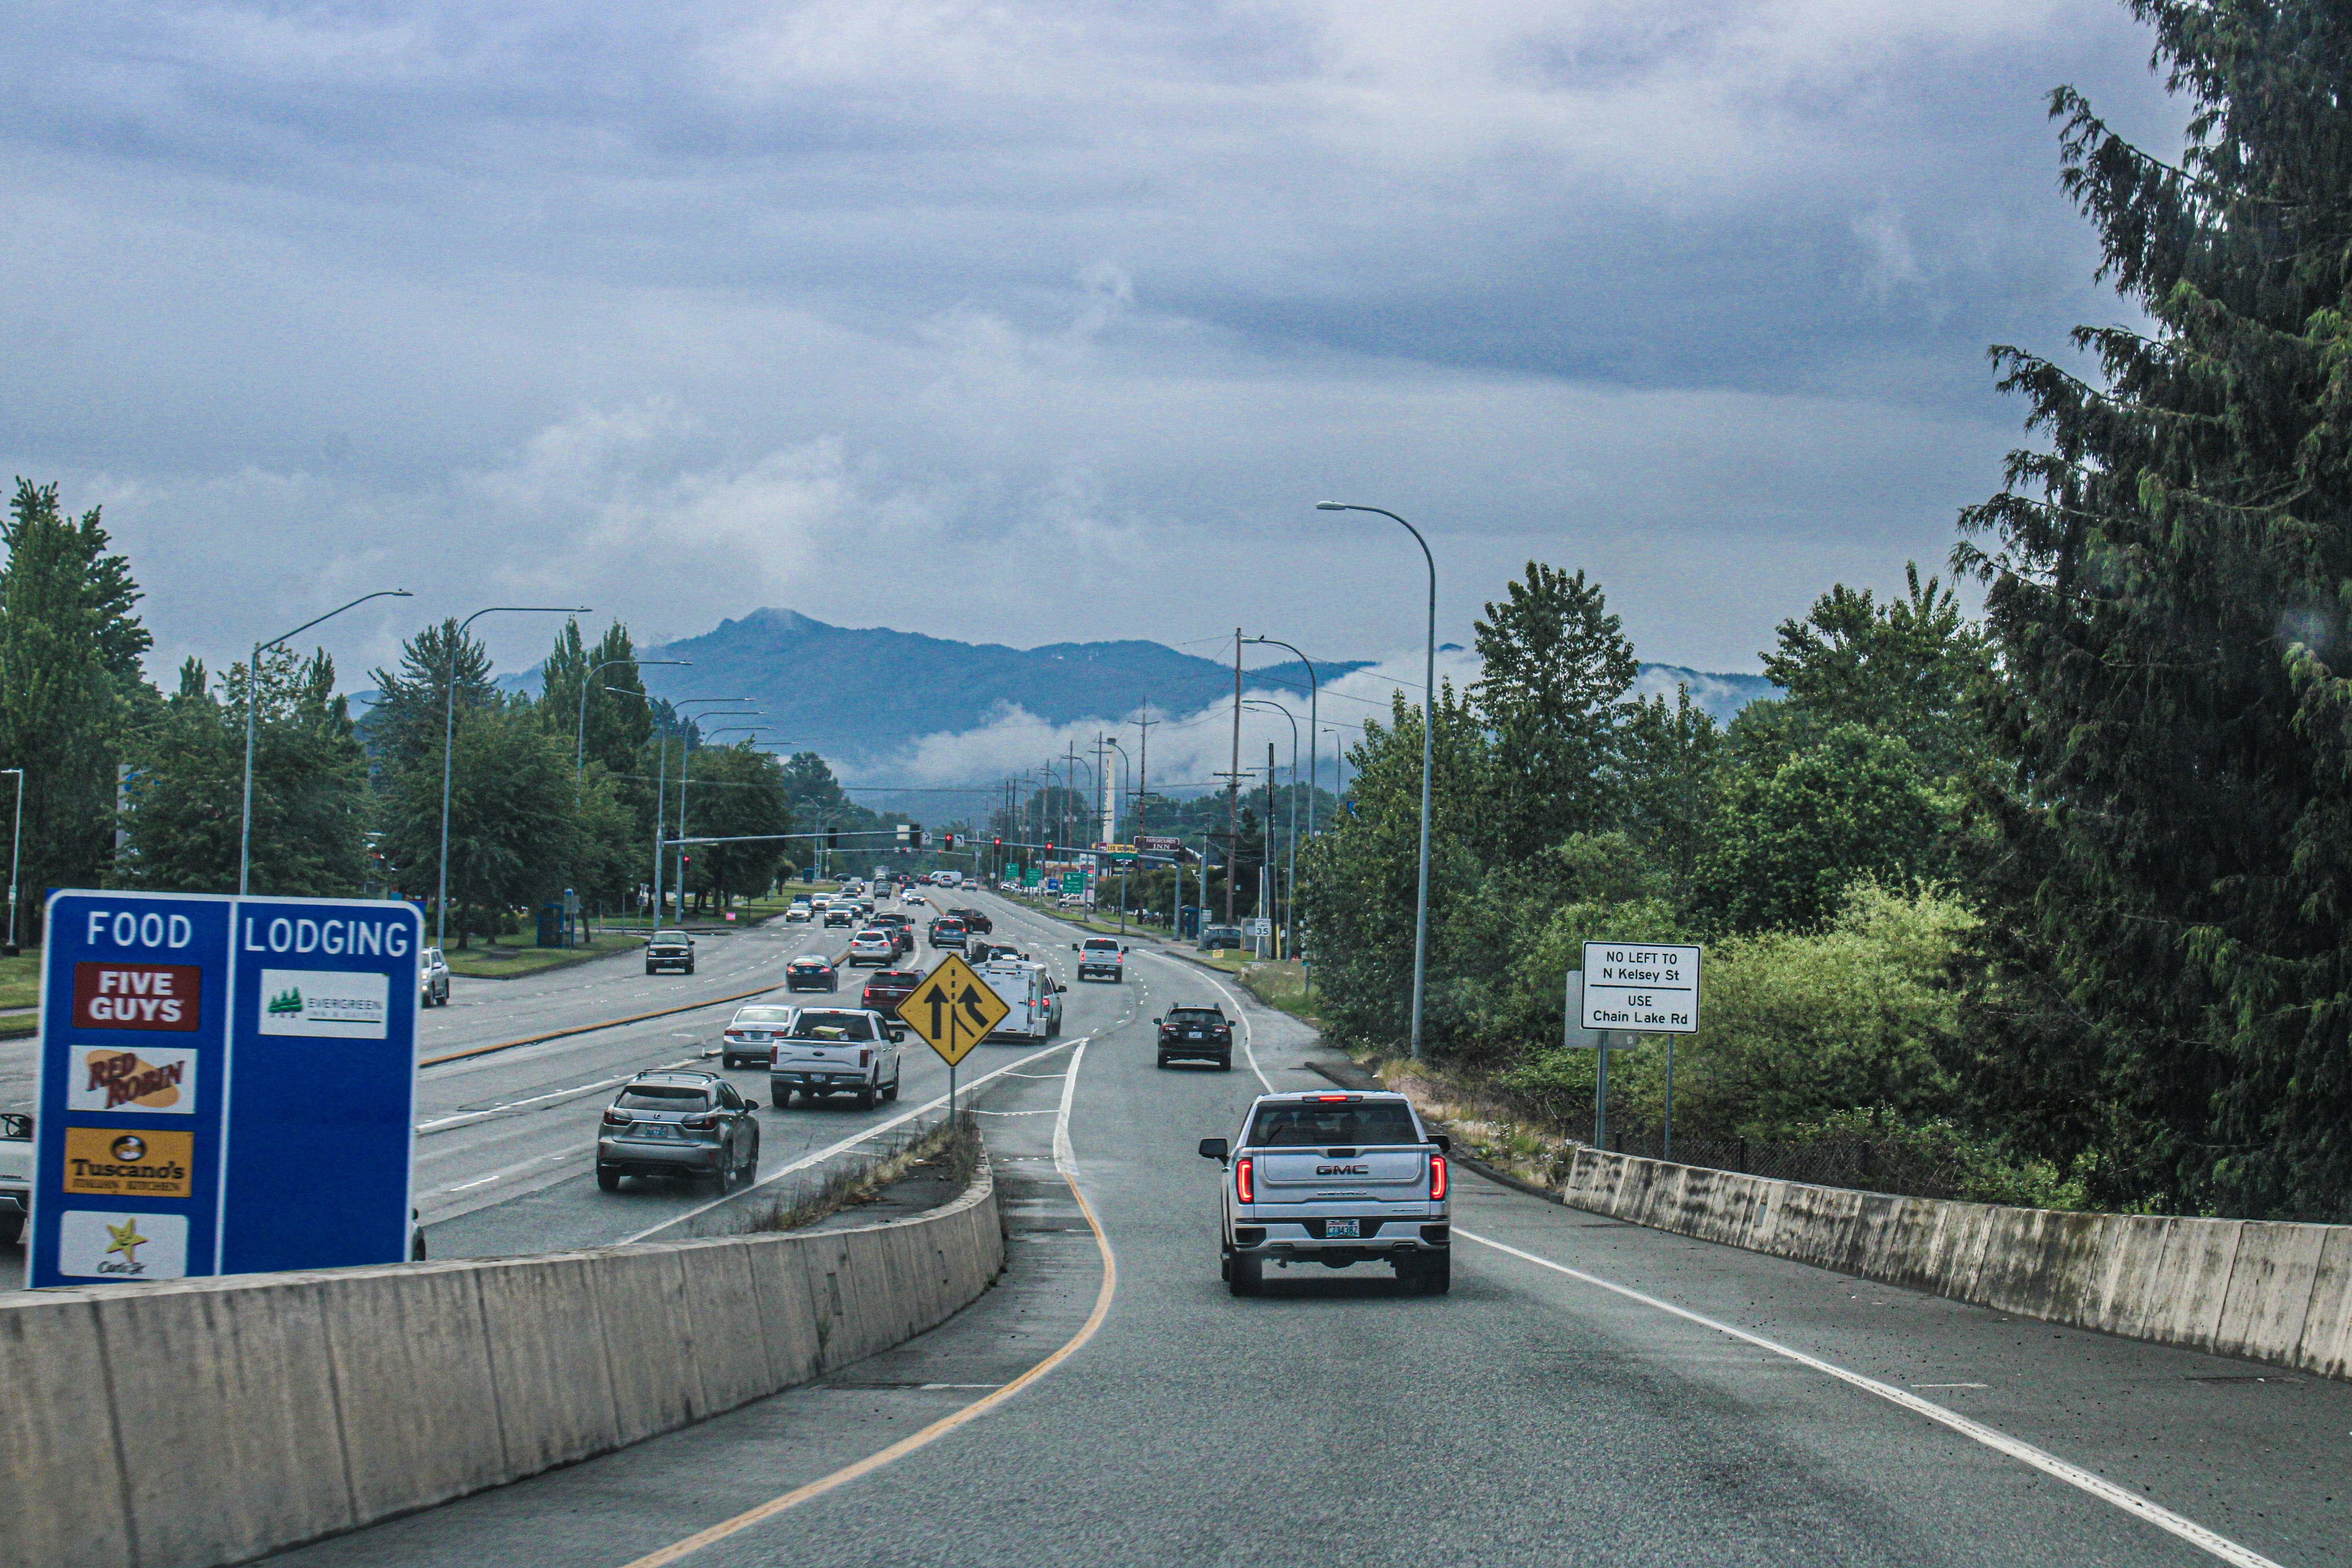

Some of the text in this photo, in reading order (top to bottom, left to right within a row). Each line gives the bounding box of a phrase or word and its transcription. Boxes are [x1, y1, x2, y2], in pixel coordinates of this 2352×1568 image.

[87, 911, 193, 948] FOOD
[244, 917, 408, 957] LODGING
[1607, 951, 1677, 964] NO LEFT TO
[99, 970, 174, 996] FIVE
[1603, 968, 1679, 982] N Kelsey St
[88, 996, 182, 1022] GUYS
[307, 998, 383, 1010] EVERGREEN
[1628, 995, 1652, 1006] USE
[1593, 1010, 1688, 1024] Chain Lake Rd
[85, 1052, 136, 1091] RED
[104, 1060, 185, 1109] ROBIN
[71, 1158, 185, 1179] Tuscano's
[1316, 1165, 1369, 1175] GMC
